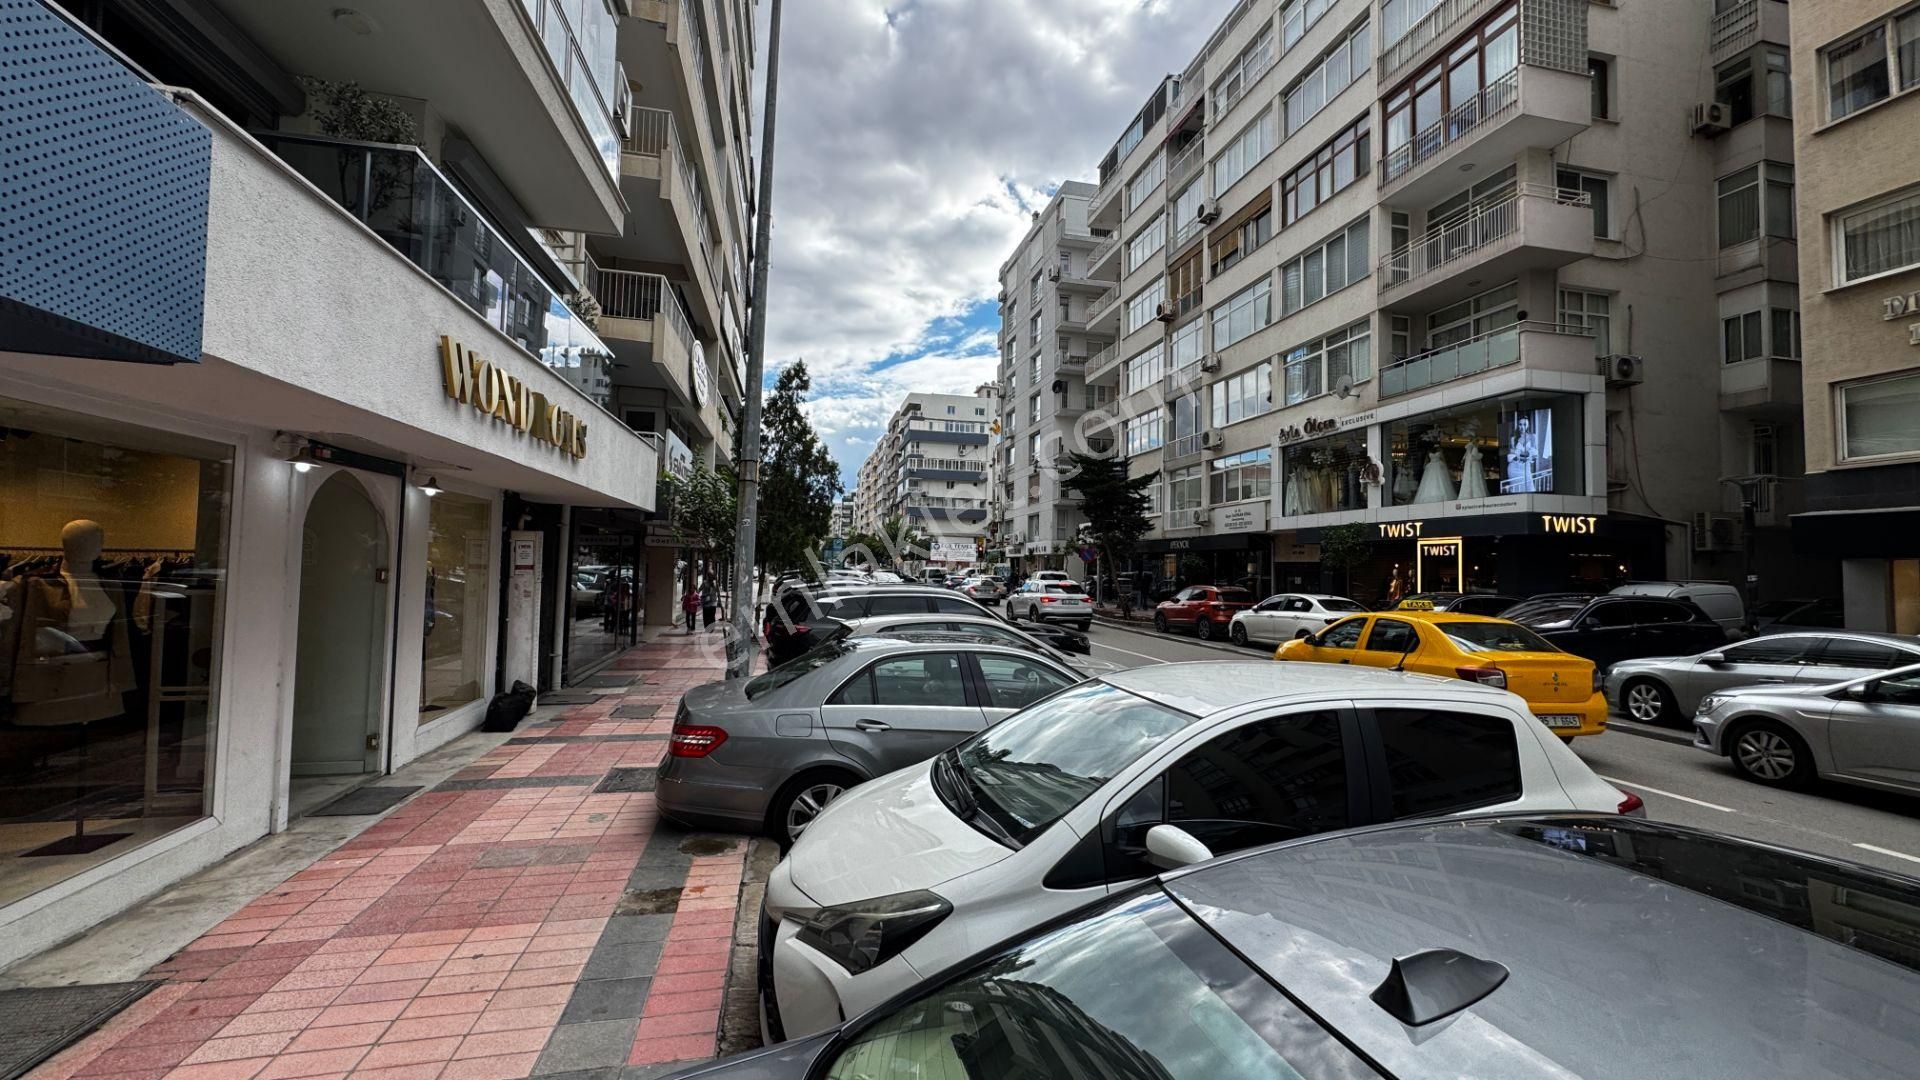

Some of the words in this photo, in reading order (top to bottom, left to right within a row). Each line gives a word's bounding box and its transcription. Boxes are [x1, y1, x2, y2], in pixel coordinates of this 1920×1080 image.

[440, 335, 587, 459] WONDOUS
[1341, 413, 1374, 427] EXCLUSIVE
[1379, 522, 1423, 537] TWIST
[1542, 516, 1597, 534] TWIST
[1424, 545, 1456, 556] TWIST
[1552, 717, 1557, 725] T
